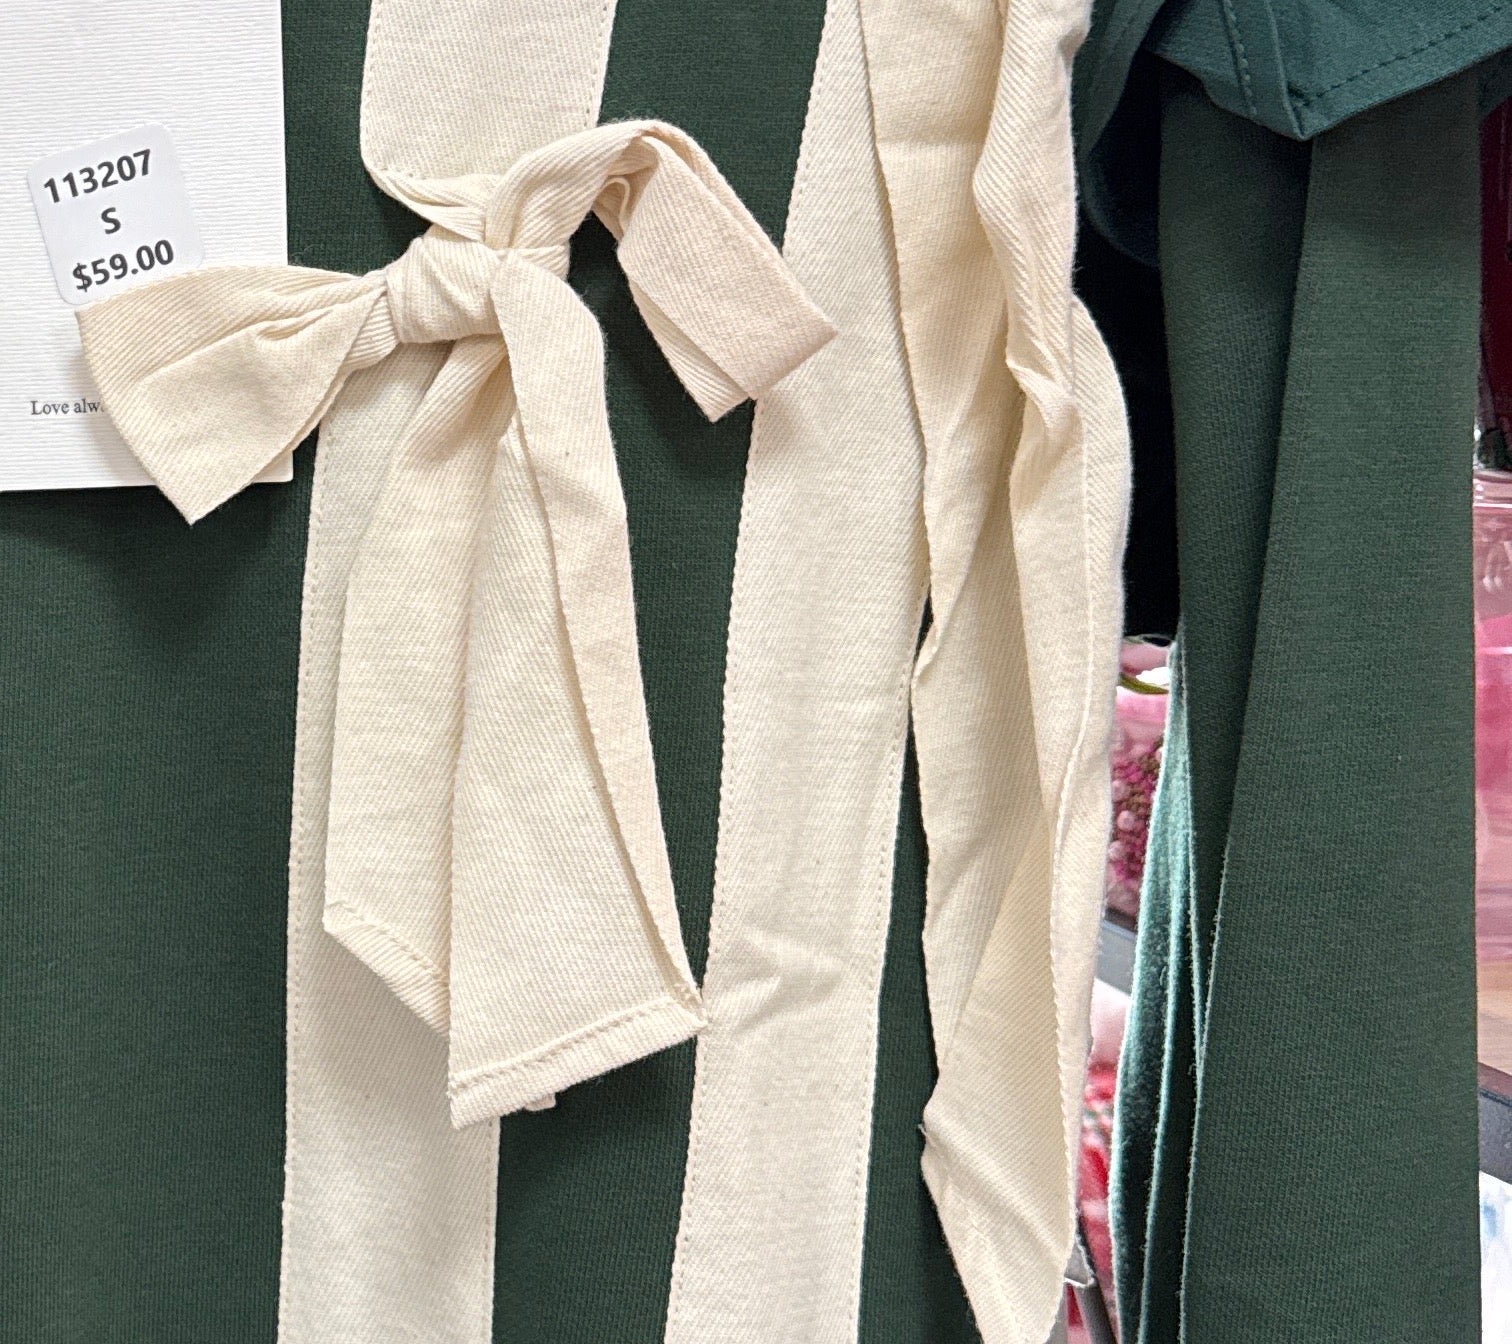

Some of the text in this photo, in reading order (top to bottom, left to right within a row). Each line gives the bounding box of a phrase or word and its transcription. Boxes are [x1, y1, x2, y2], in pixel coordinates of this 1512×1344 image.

[44, 148, 152, 204] 113207
[100, 207, 122, 235] S
[72, 239, 174, 292] $59.00
[30, 400, 70, 415] Love
